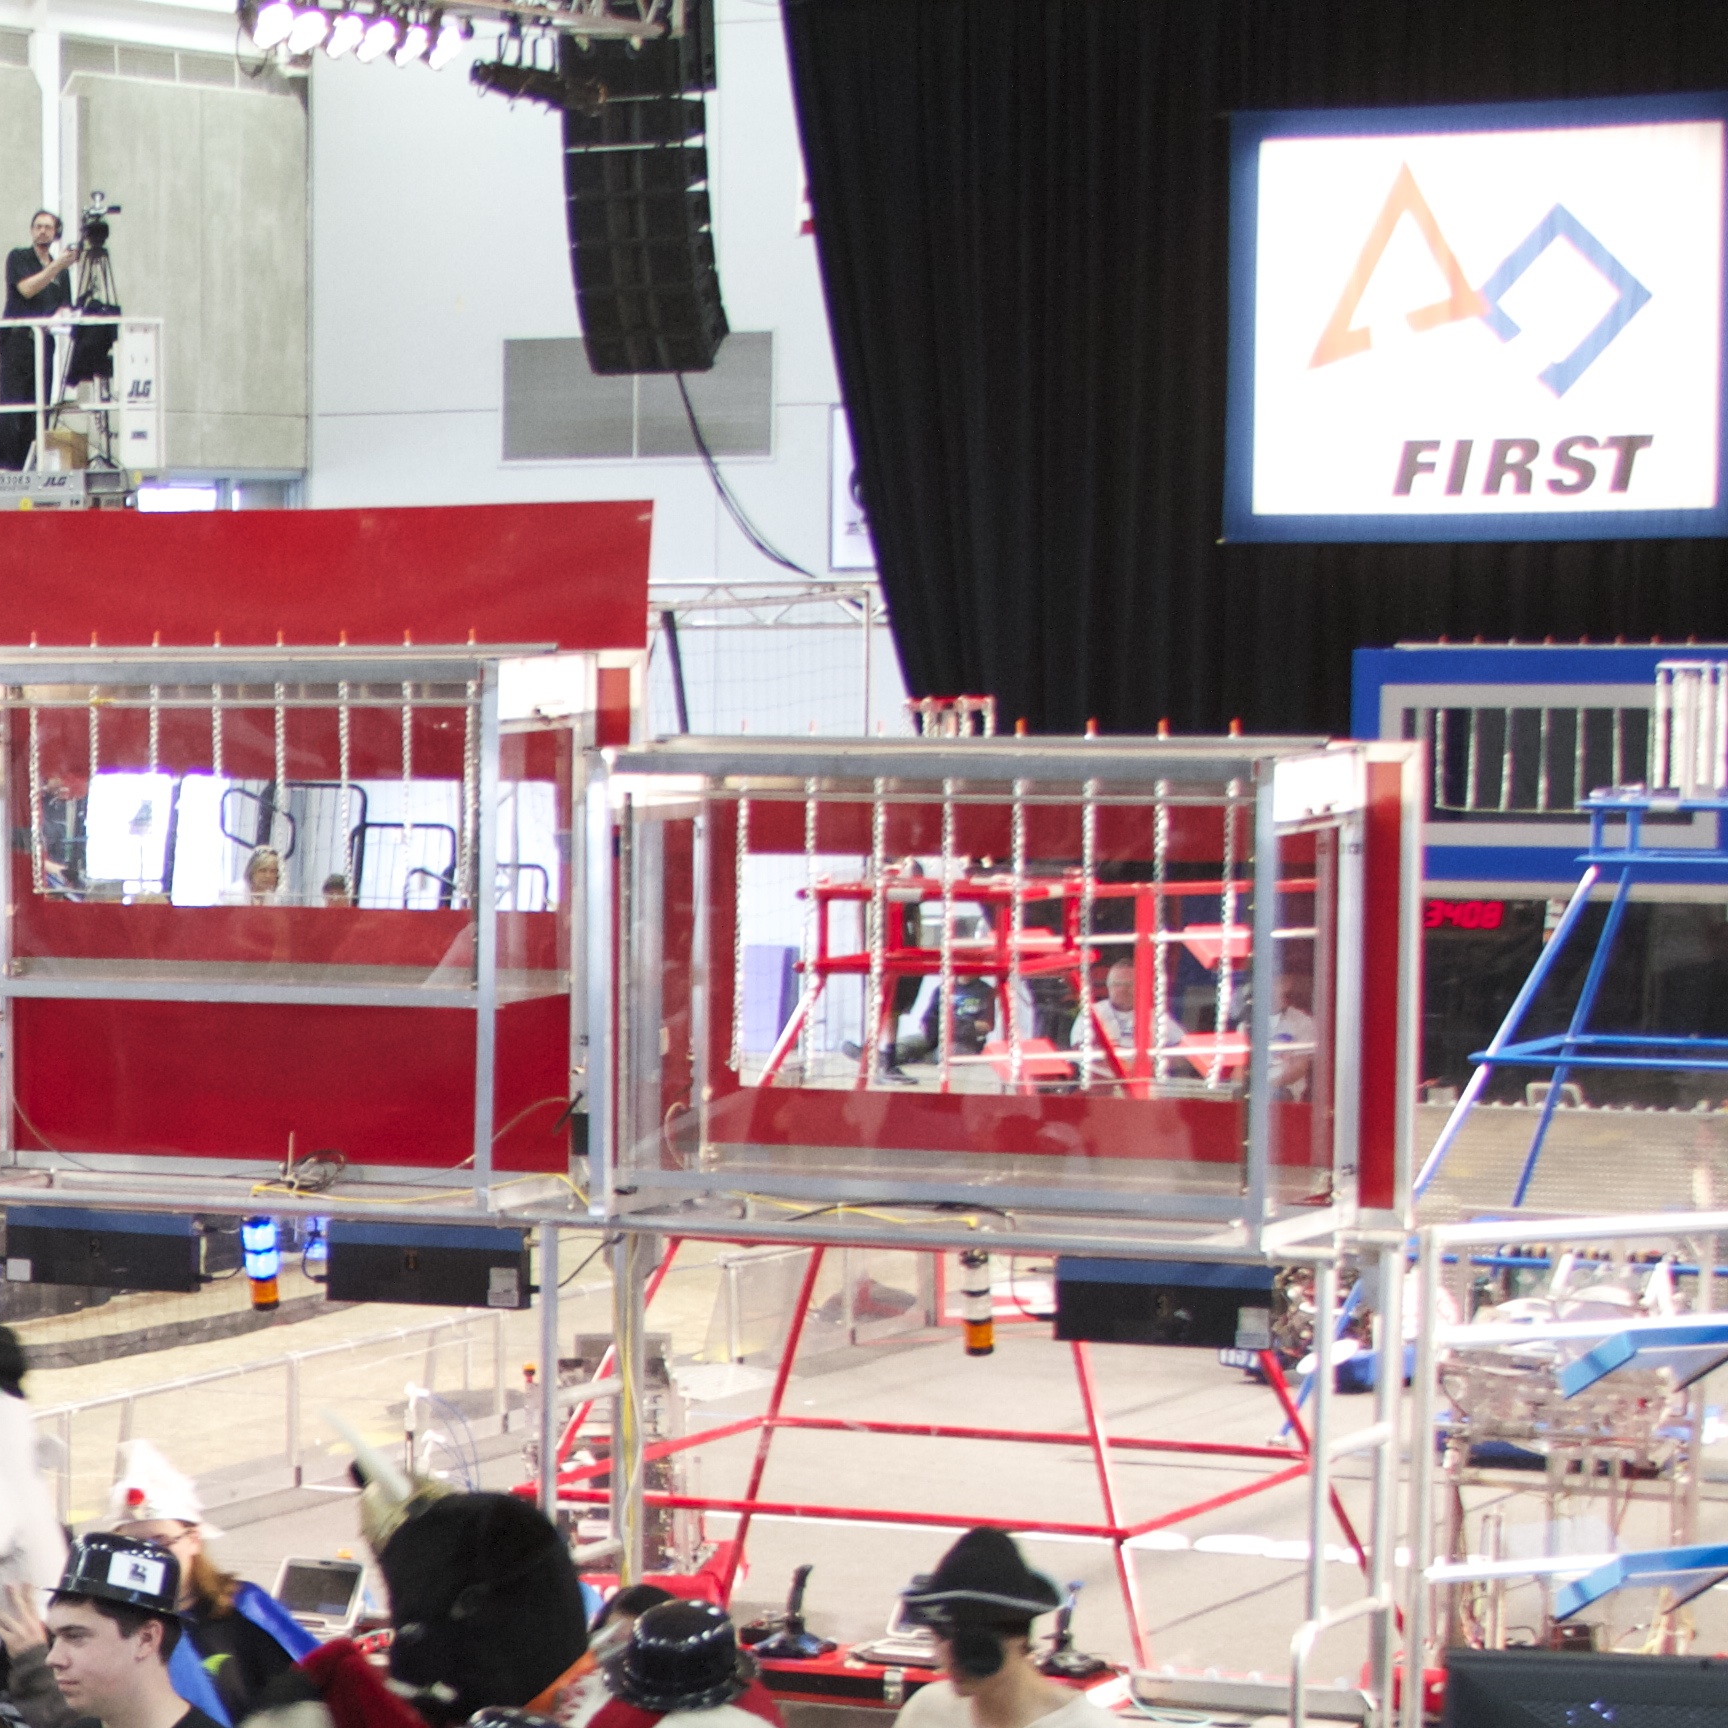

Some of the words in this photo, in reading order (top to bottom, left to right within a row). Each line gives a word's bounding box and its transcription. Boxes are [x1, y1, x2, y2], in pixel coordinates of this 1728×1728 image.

[128, 379, 152, 398] JLG
[1392, 433, 1653, 498] FIRST
[44, 475, 68, 488] JLG
